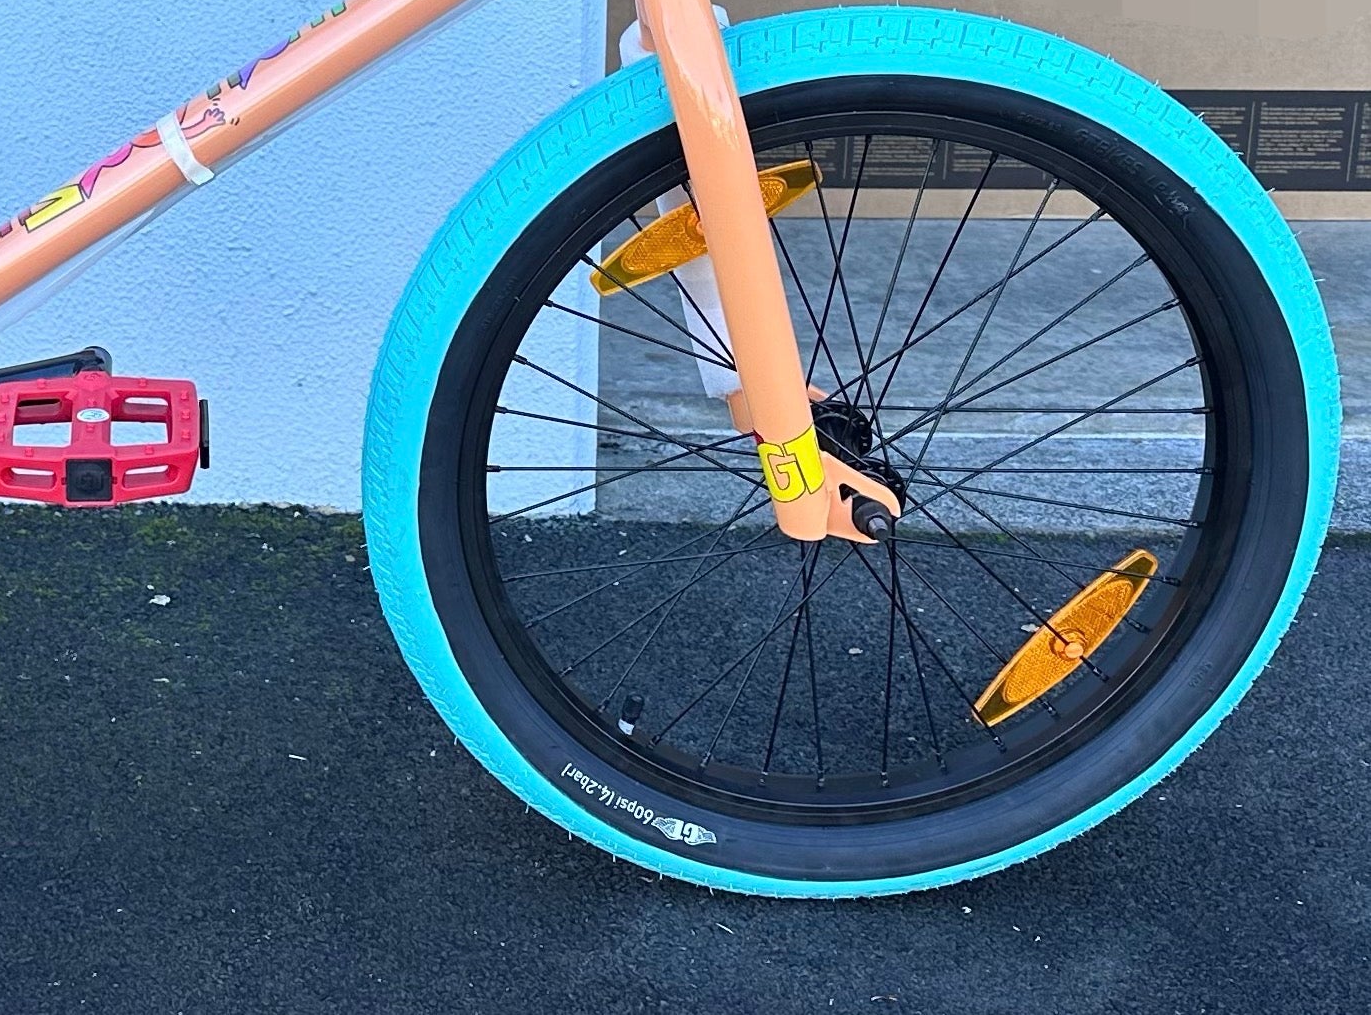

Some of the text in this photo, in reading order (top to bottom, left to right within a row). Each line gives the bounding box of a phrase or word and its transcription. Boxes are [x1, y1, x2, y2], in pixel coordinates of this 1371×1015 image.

[756, 423, 825, 503] GT
[560, 762, 615, 807] (4.2bar)
[613, 796, 655, 825] 60psi
